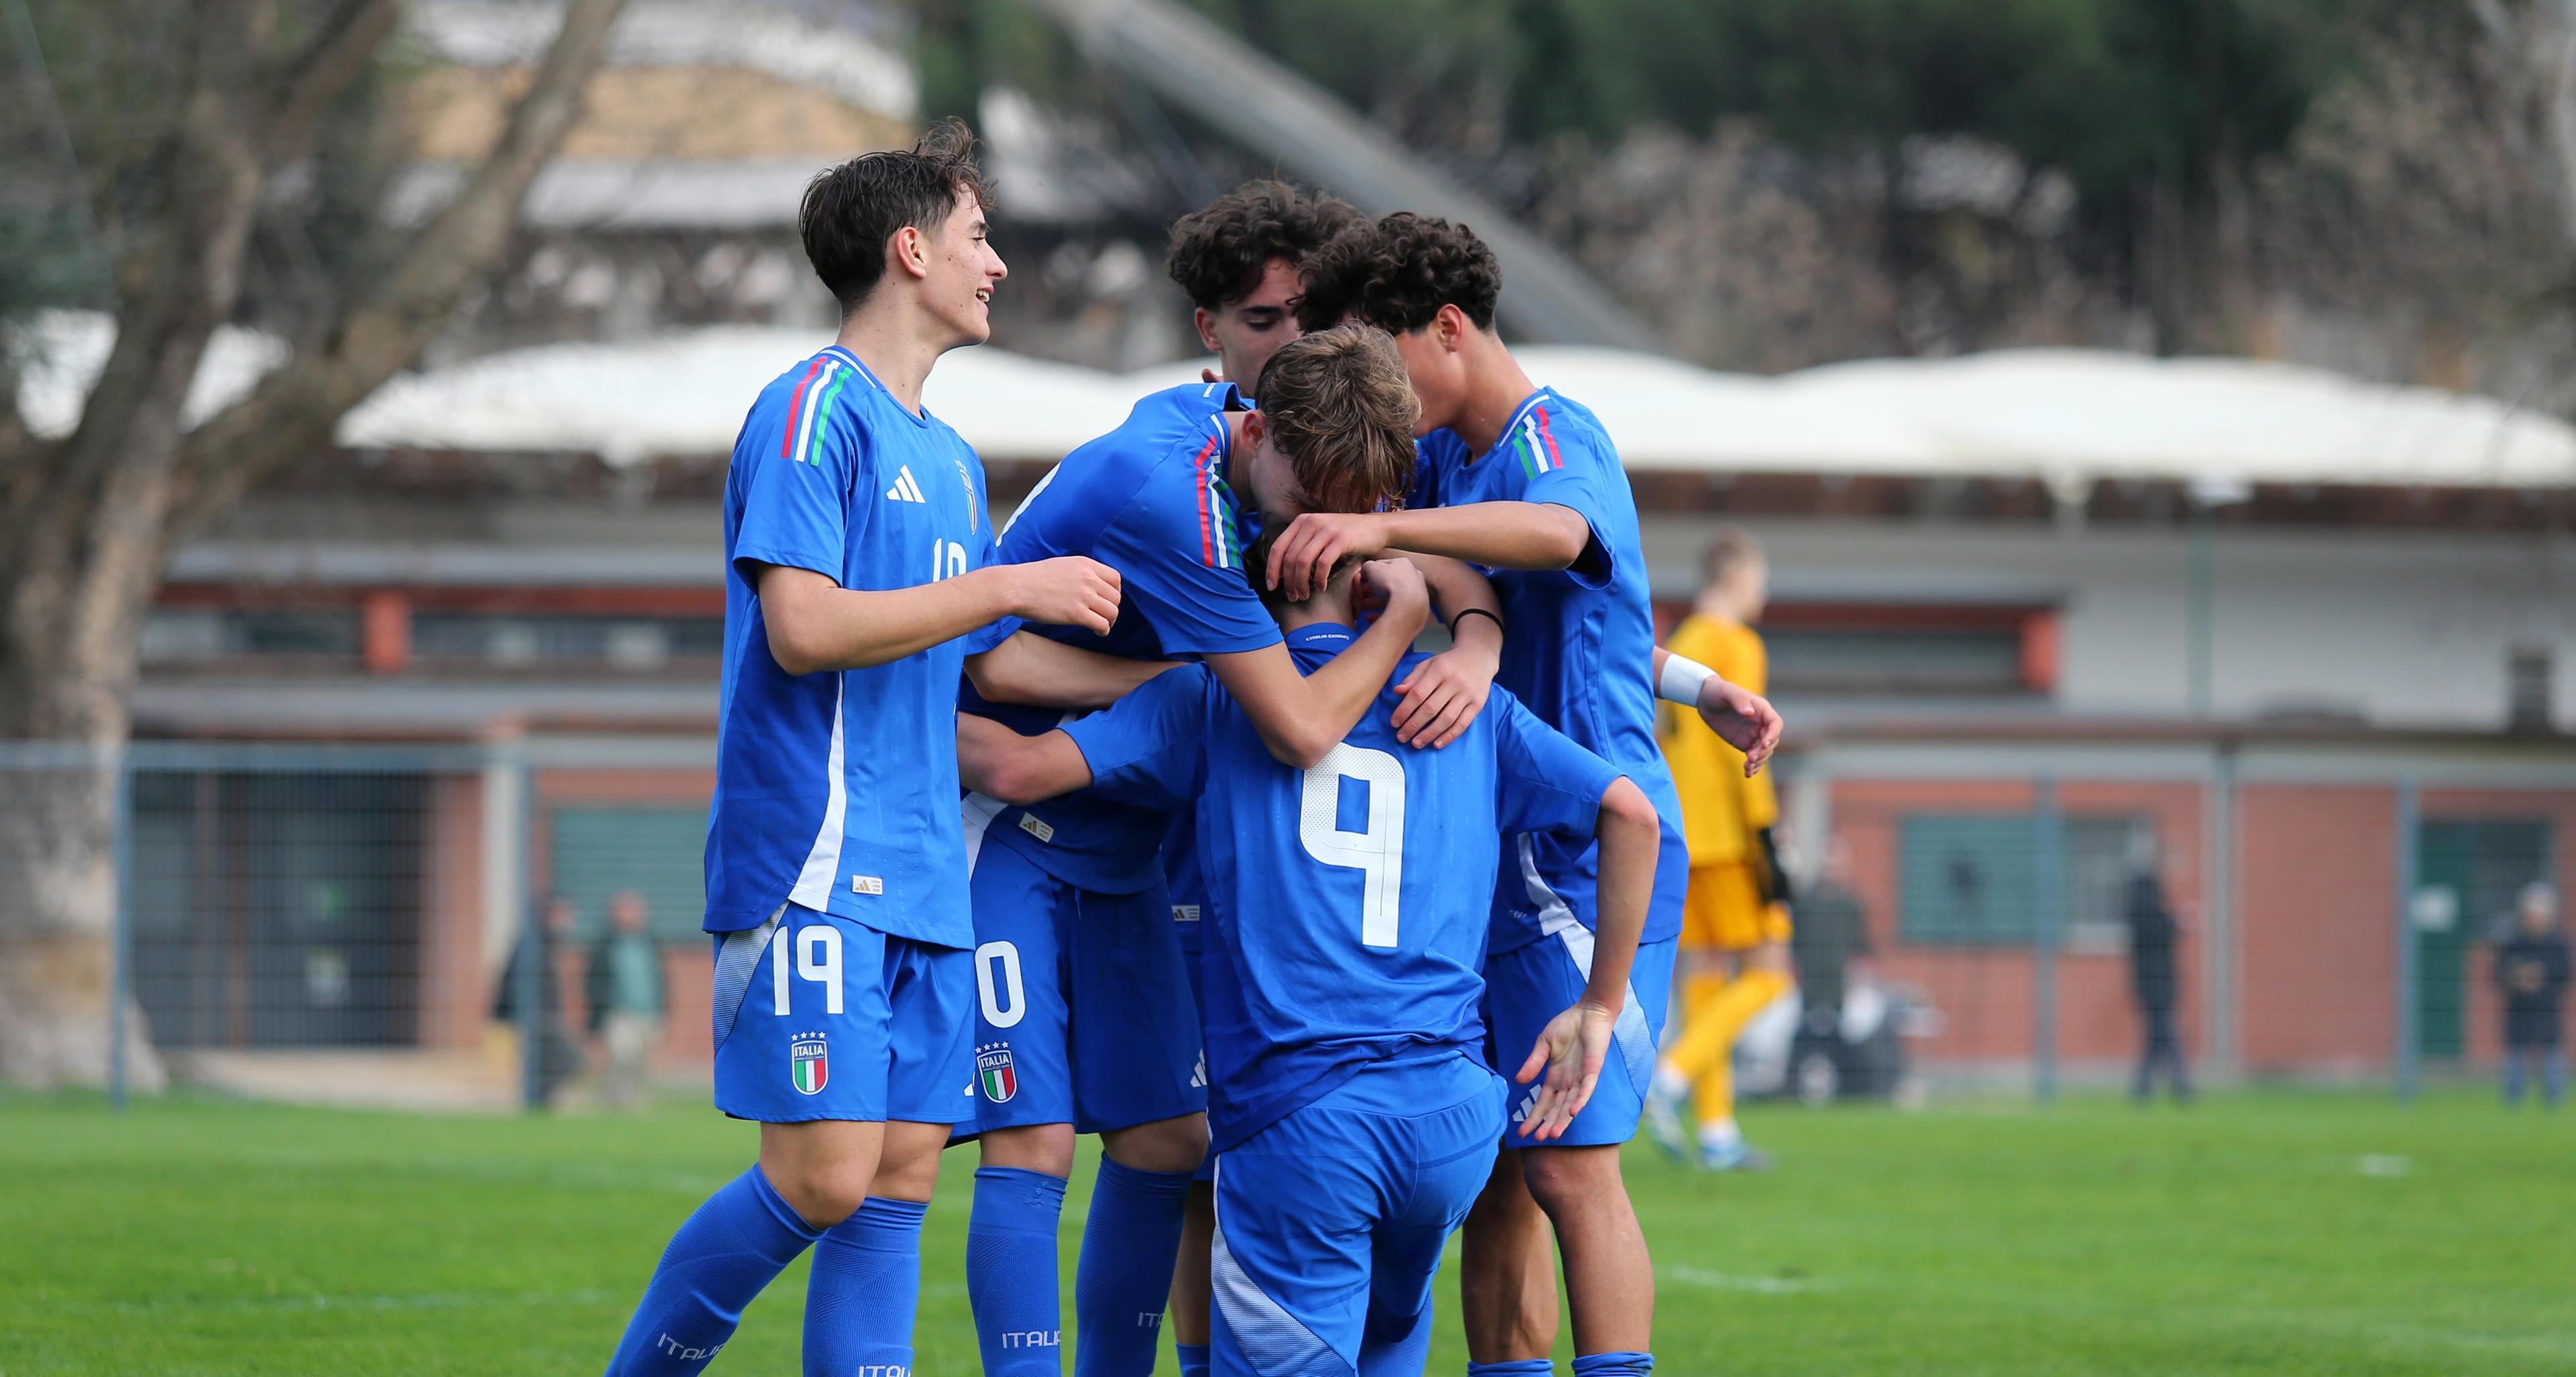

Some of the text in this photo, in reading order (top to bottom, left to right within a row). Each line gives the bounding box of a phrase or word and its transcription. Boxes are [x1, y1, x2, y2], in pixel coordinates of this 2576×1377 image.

[1299, 741, 1405, 948] 9
[773, 926, 844, 1015] 19
[795, 1044, 824, 1057] ITALIA
[980, 1054, 1010, 1068] ITALIA
